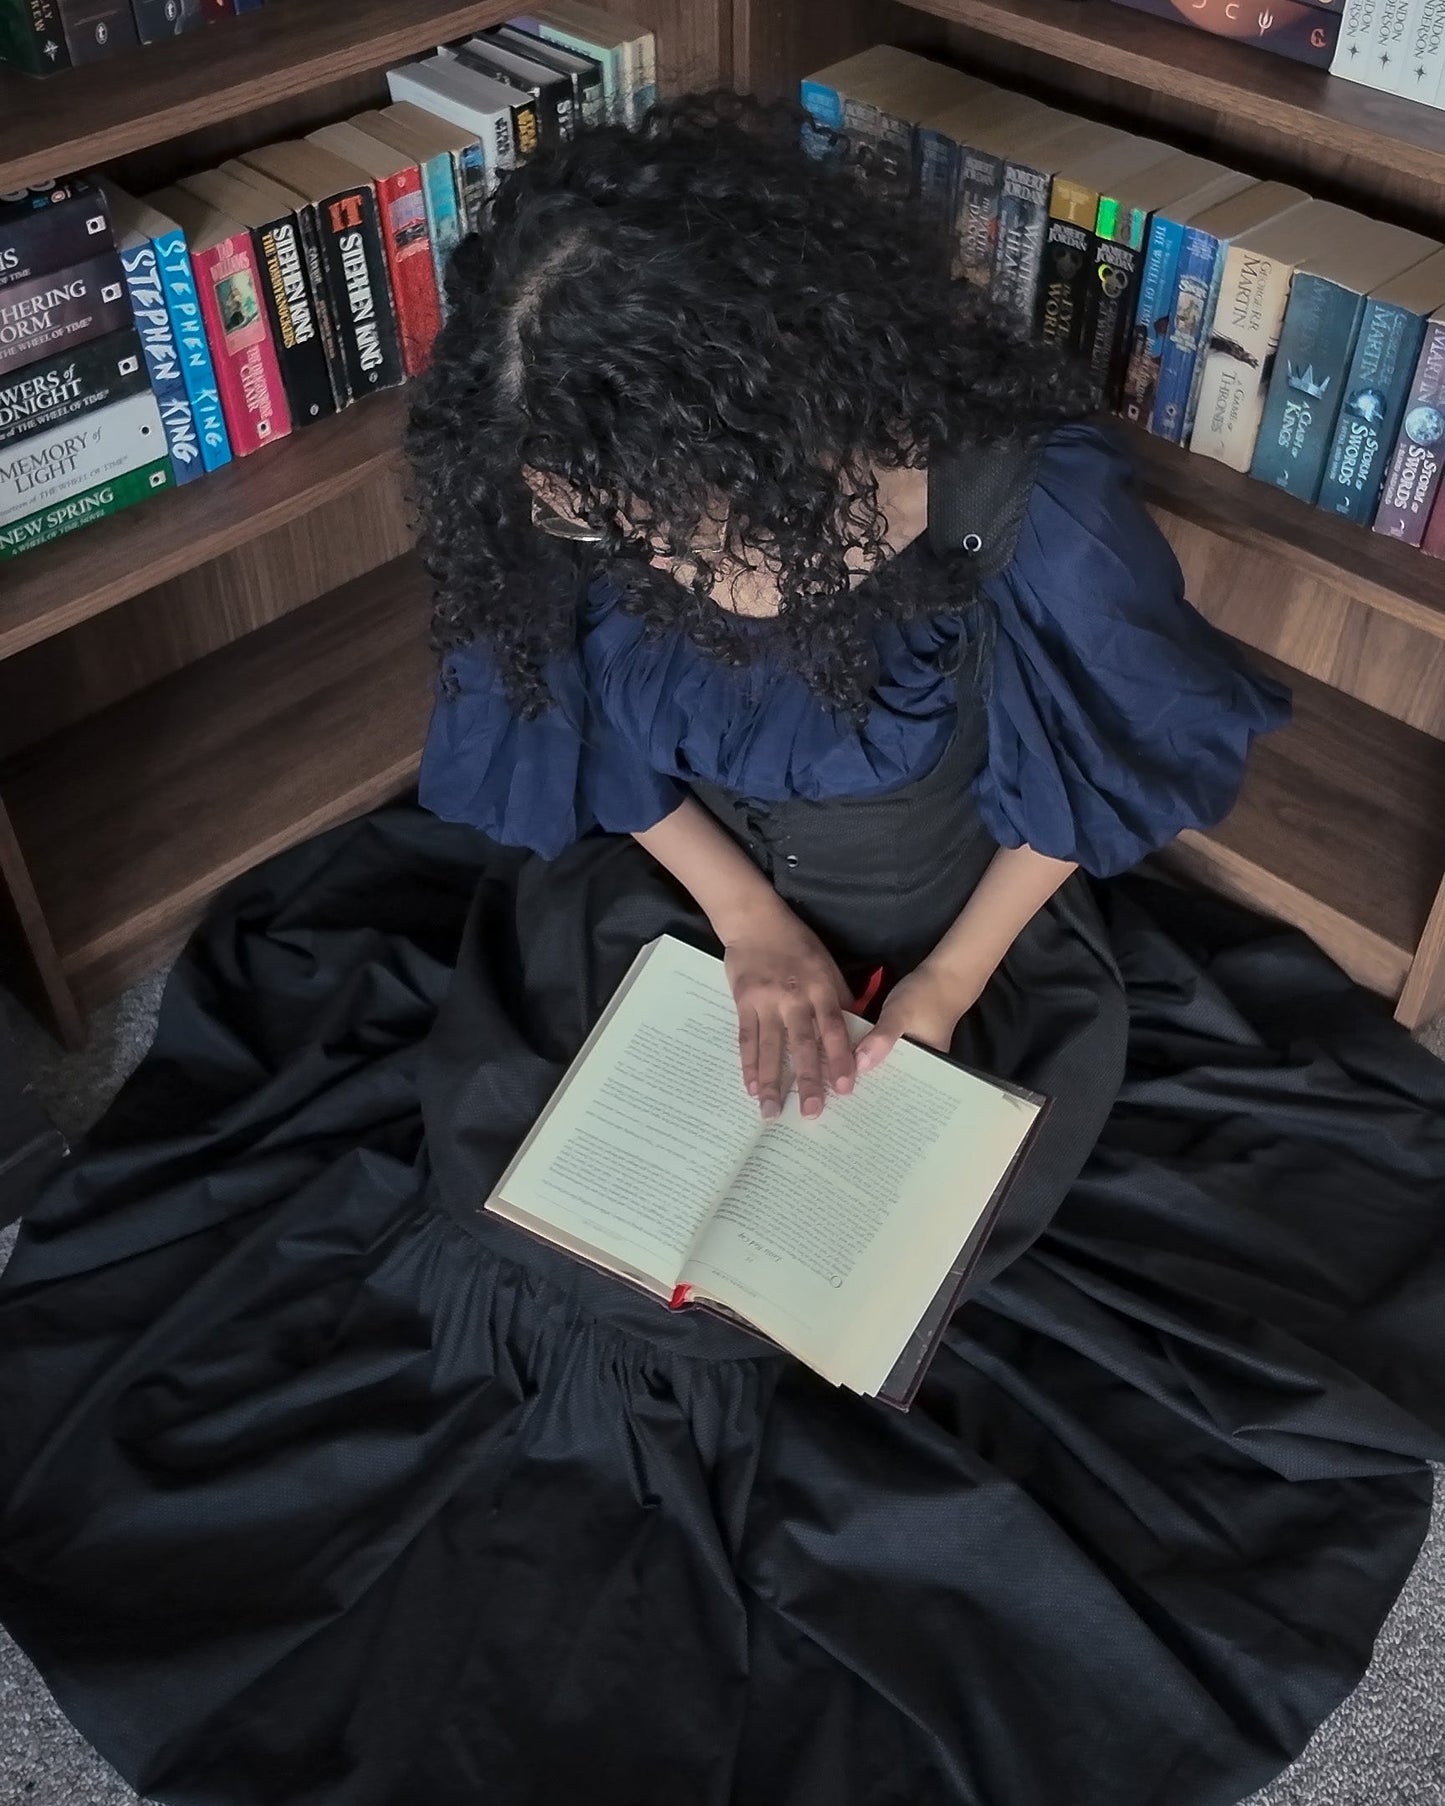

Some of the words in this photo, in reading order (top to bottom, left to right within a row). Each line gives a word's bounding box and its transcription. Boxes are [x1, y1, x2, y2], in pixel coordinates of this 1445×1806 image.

[327, 194, 364, 234] IT
[262, 230, 278, 258] THE
[272, 223, 308, 303] STEPHEN
[266, 254, 297, 350] TOMMYKNOCKERS
[339, 232, 376, 323] STEPHEN
[1231, 254, 1261, 329] MARTIN
[154, 238, 207, 368] STEPHEN
[190, 387, 223, 449] KING
[288, 299, 316, 345] KING
[354, 321, 384, 372] KING
[1359, 305, 1396, 383] MARTIN
[63, 363, 76, 384] of
[121, 248, 181, 381] STEPHEN
[160, 397, 200, 465] KING
[240, 364, 260, 414] CHAIR
[1210, 371, 1237, 434] THRONES
[1277, 399, 1303, 449] KINGS
[1293, 410, 1313, 450] CLASH
[0, 431, 88, 483] MEMORY
[14, 454, 77, 494] LIGHT
[1338, 421, 1369, 487] SWORDS
[1357, 437, 1379, 482] STORM
[1393, 444, 1427, 511] SWORDS
[1413, 459, 1438, 505] STORM
[0, 517, 43, 551] NEW
[45, 486, 115, 529] SPRING
